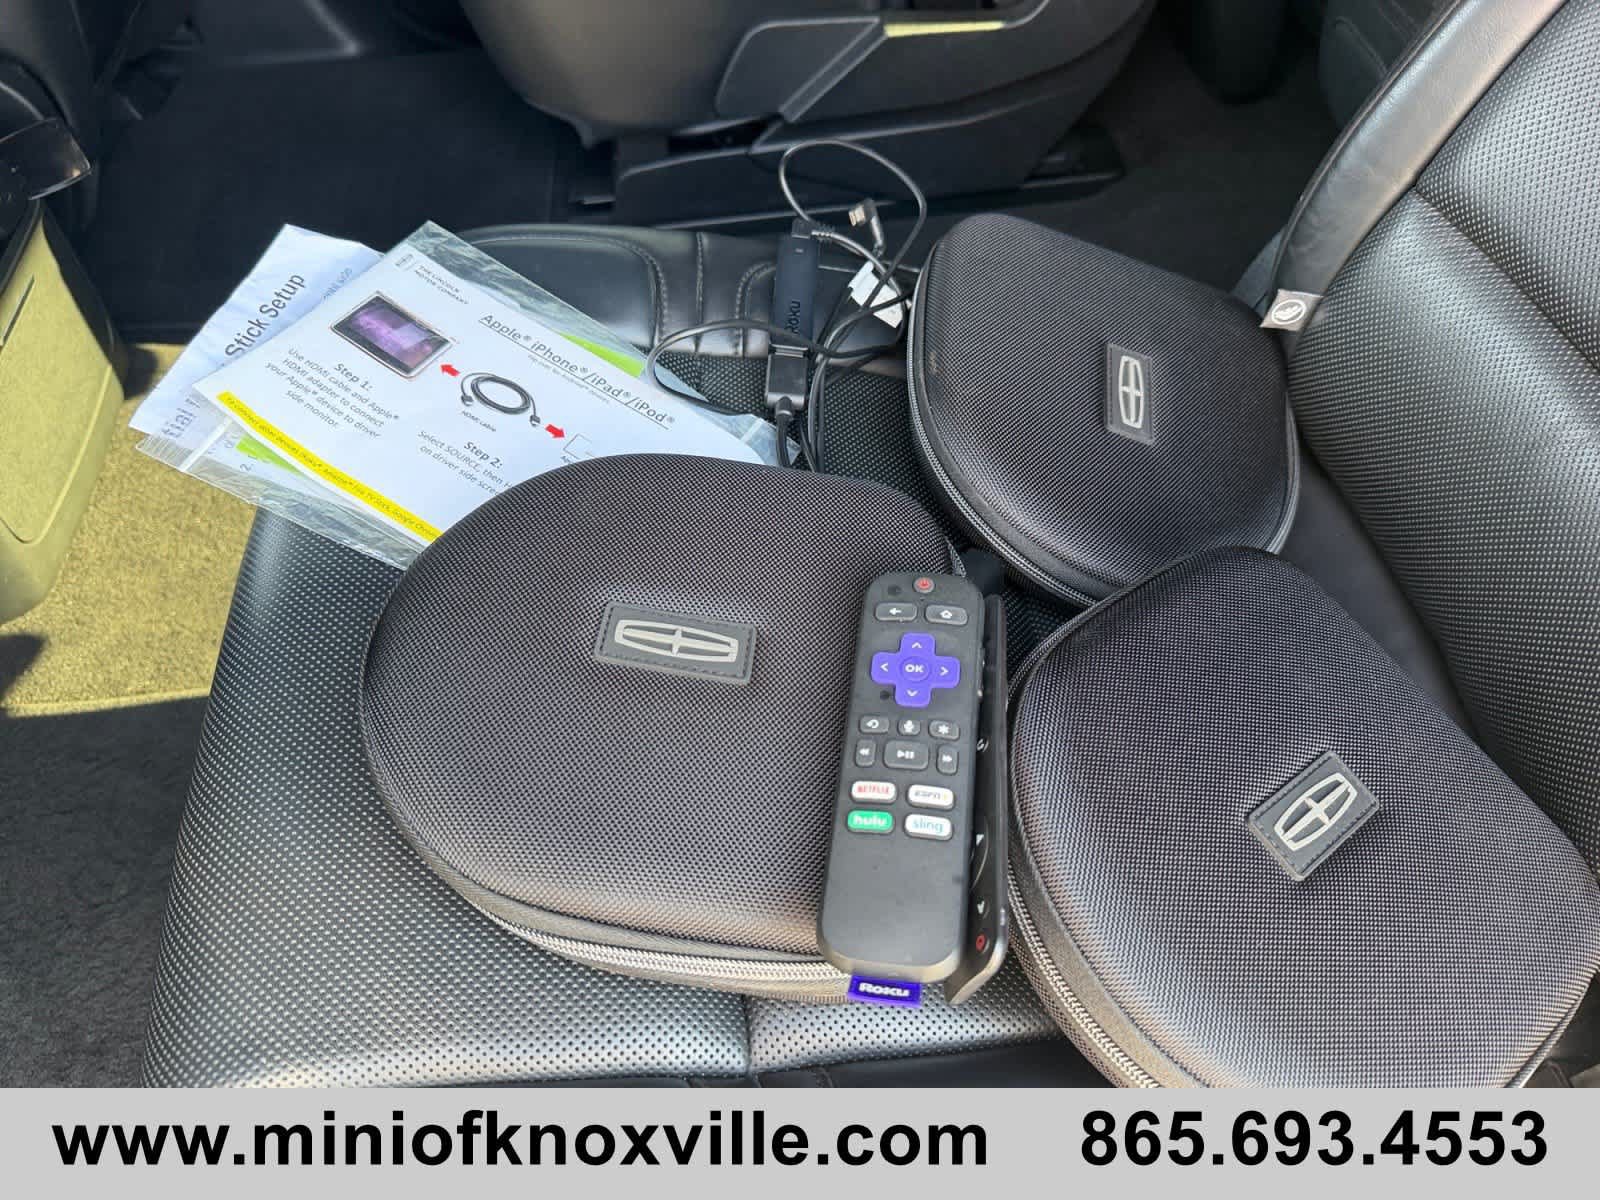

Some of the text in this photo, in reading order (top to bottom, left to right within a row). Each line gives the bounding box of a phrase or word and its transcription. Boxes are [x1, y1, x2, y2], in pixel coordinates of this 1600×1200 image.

[223, 271, 306, 360] Stick Setup
[287, 347, 305, 362] Use
[302, 357, 330, 378] HDMI
[327, 374, 352, 394] cable
[350, 388, 369, 404] and
[332, 361, 374, 392] Step 1:
[264, 361, 287, 379] your
[314, 394, 345, 417] device
[343, 413, 355, 424] to
[353, 419, 381, 440] driver
[281, 357, 385, 428] HDMI adapter to connect
[284, 388, 305, 405] side
[417, 429, 446, 449] Select
[481, 468, 504, 485] then
[419, 445, 433, 456] on
[431, 450, 460, 471] driver
[457, 467, 479, 484] side
[462, 440, 503, 469] Step 2:
[905, 664, 924, 674] OK
[857, 785, 890, 795] NETFLIX
[853, 815, 888, 827] hulu
[913, 819, 944, 833] sling
